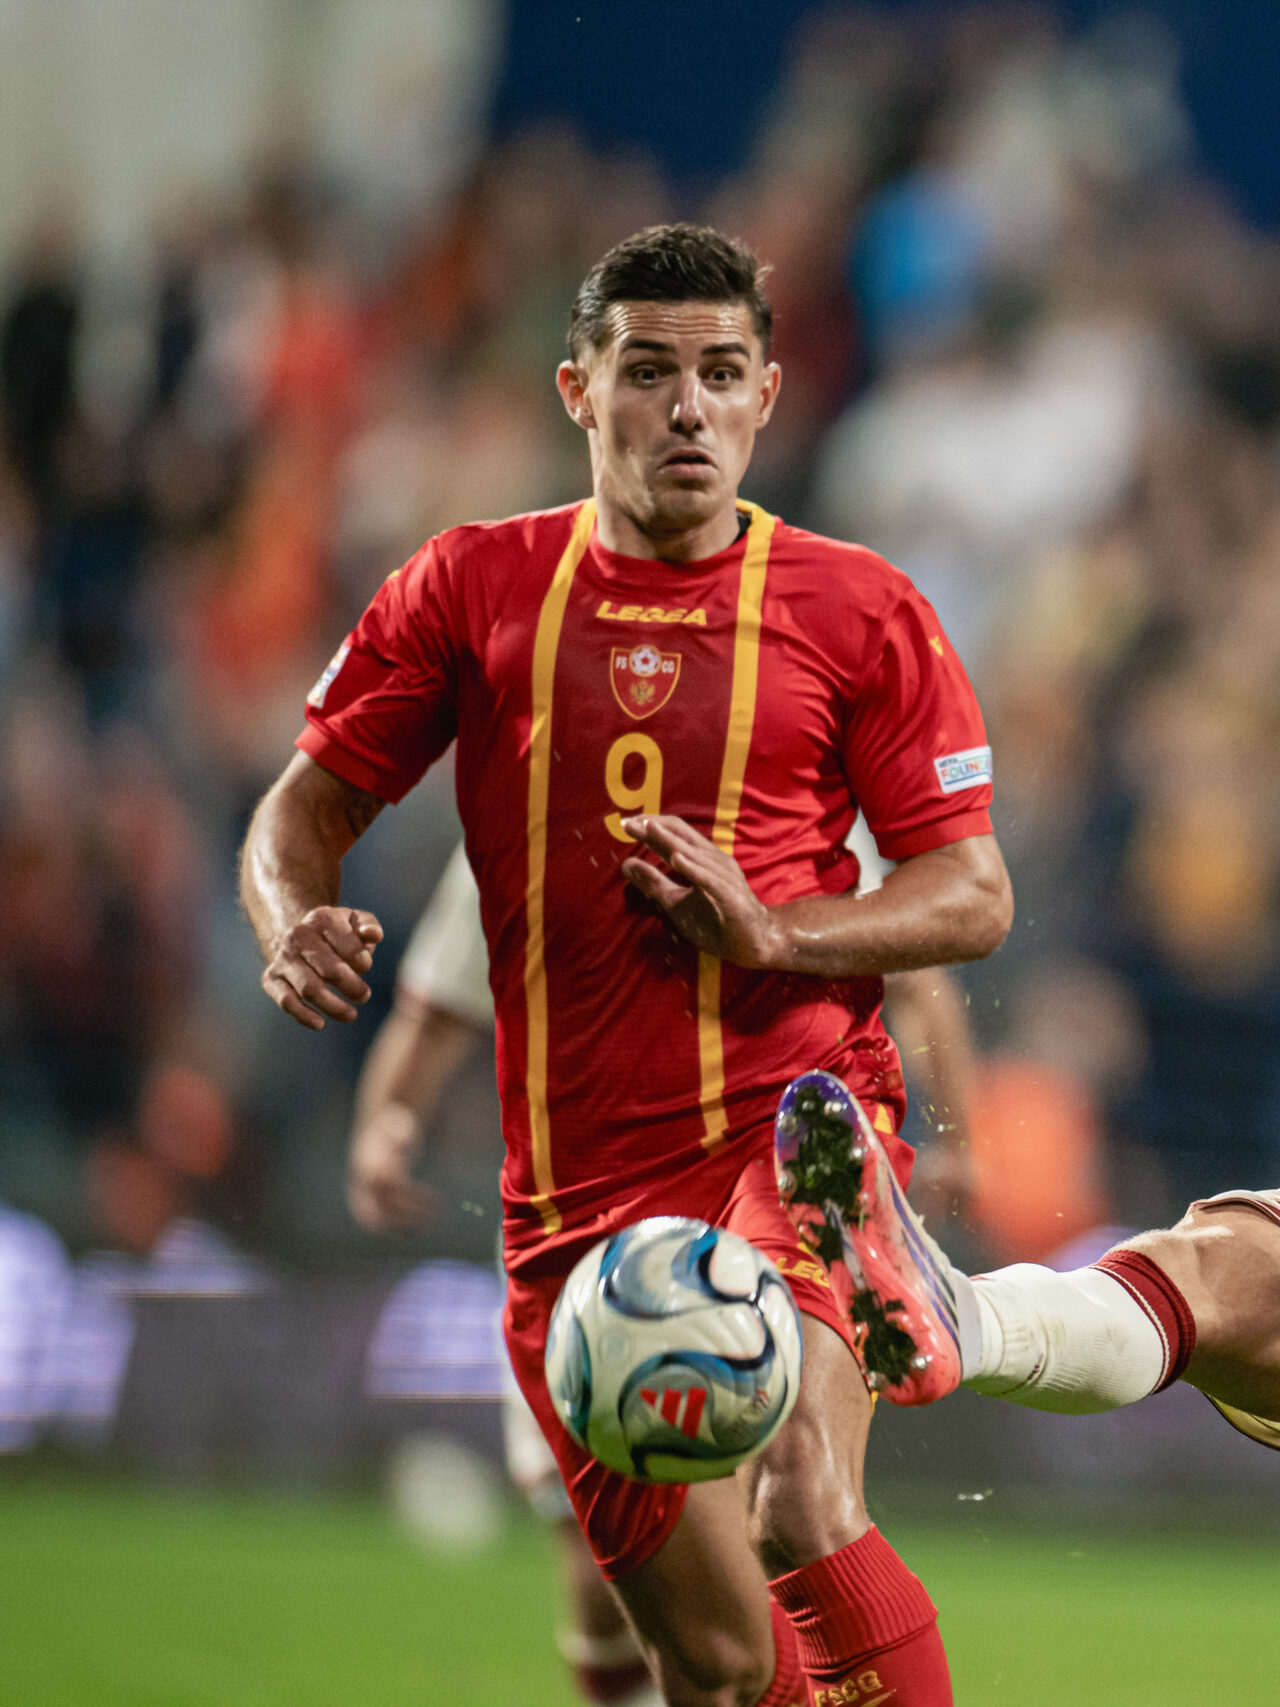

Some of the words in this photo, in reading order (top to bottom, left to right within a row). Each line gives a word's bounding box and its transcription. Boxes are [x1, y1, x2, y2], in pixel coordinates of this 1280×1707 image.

[596, 600, 707, 626] LEGEA
[604, 732, 664, 844] 9
[776, 1256, 831, 1289] LEG
[813, 1669, 884, 1707] FSCG
